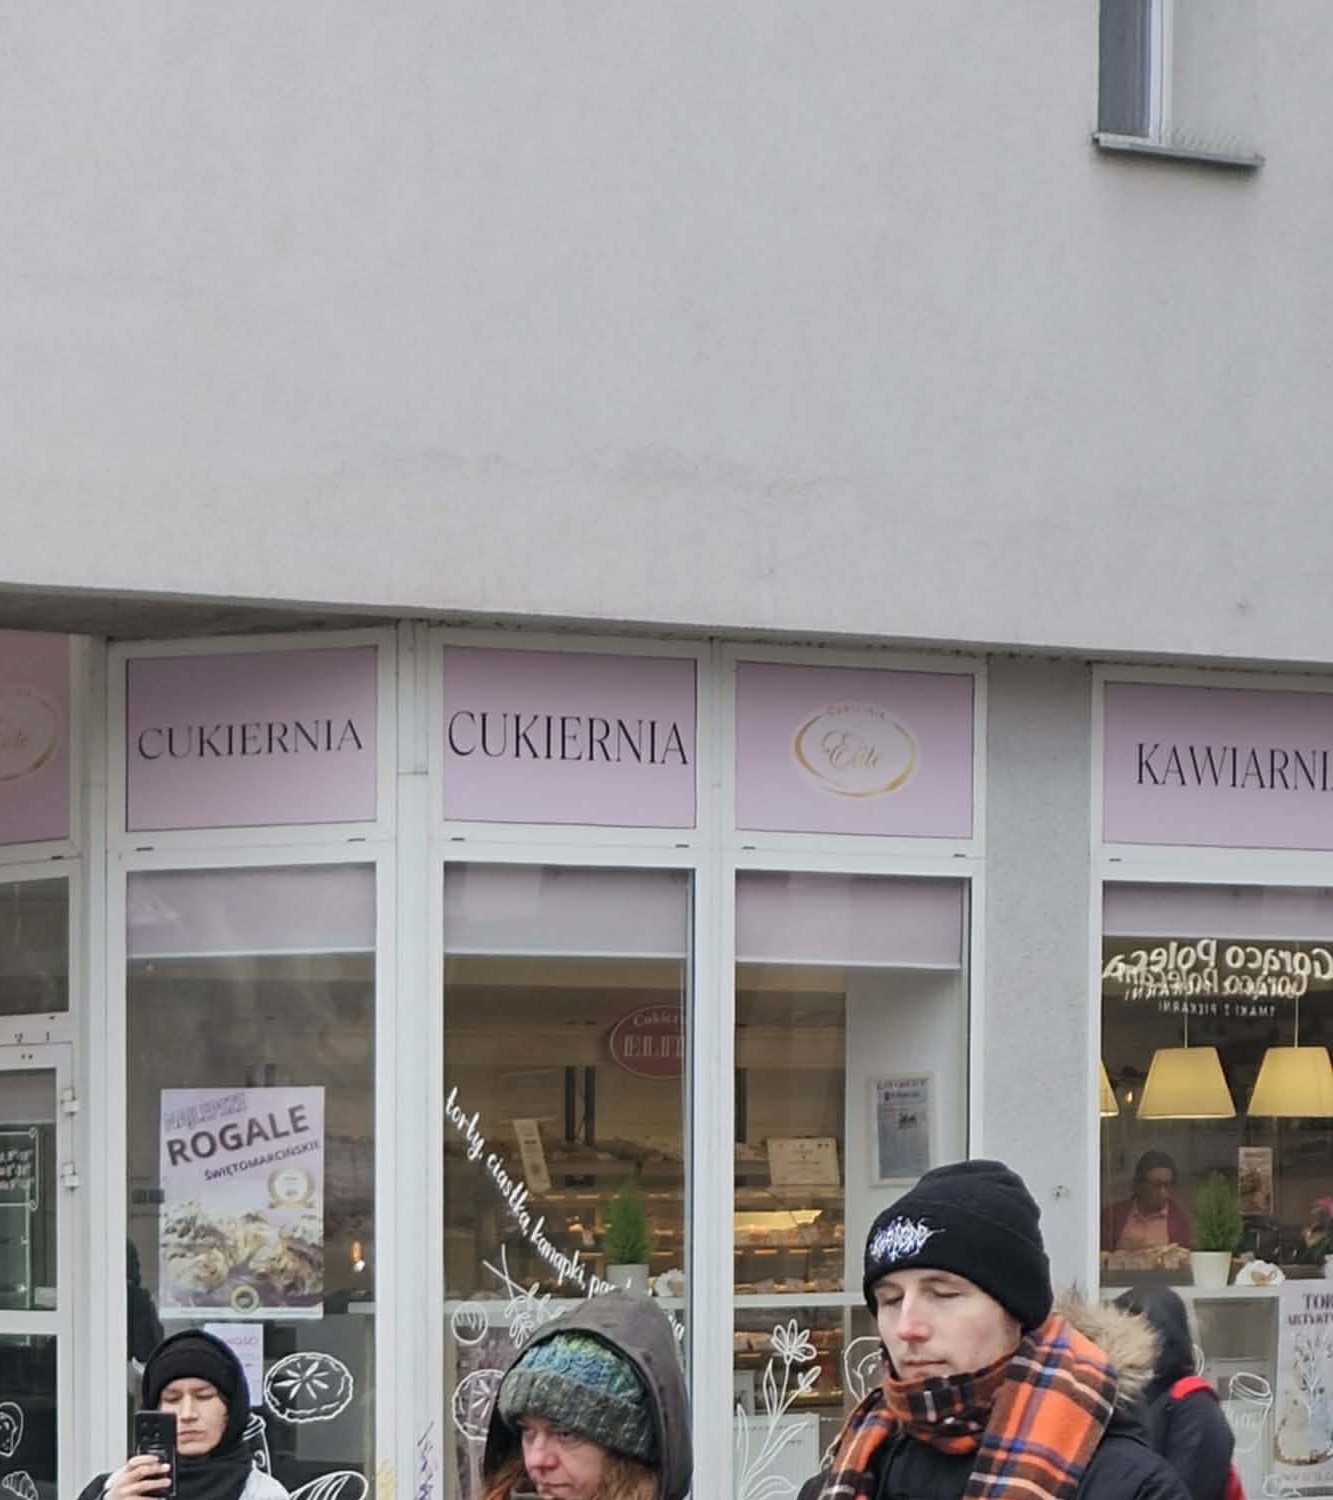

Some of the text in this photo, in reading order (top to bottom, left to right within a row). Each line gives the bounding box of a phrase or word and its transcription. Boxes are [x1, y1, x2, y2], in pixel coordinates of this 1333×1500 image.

[137, 717, 364, 760] CUKIERNIA
[447, 710, 689, 765] CUKIERNIA
[1136, 743, 1333, 791] KAWIARNI
[167, 1104, 310, 1166] ROGALE
